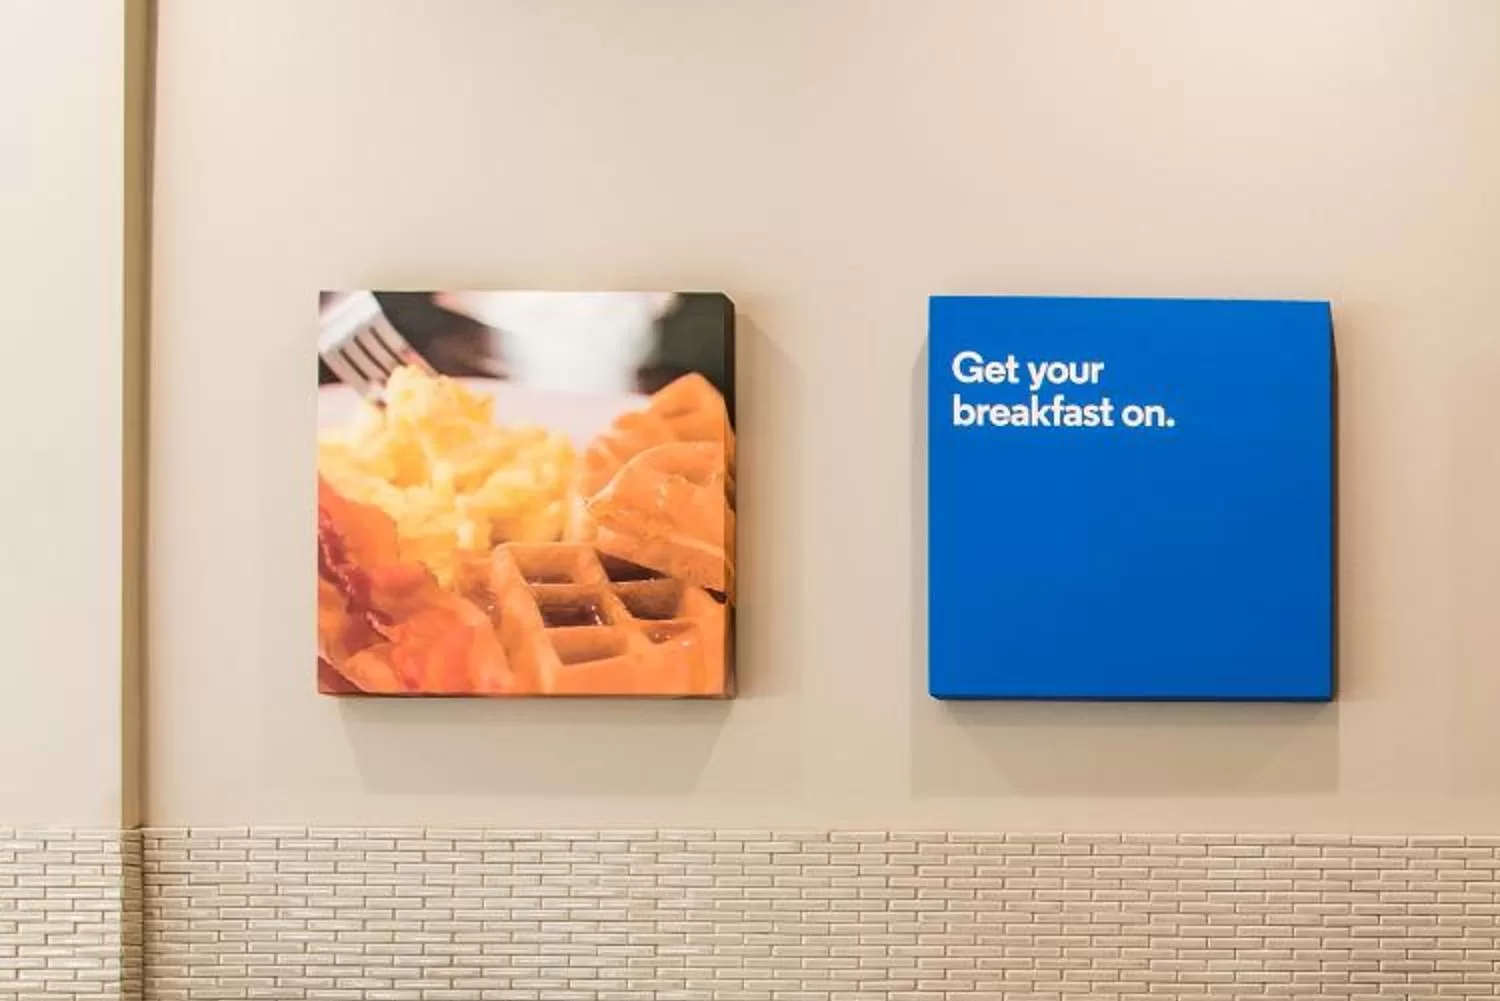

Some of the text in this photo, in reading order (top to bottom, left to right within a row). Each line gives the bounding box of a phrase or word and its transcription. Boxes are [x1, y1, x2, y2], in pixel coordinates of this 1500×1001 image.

[952, 351, 1105, 391] Get your
[953, 393, 1175, 427] breakfast on.
